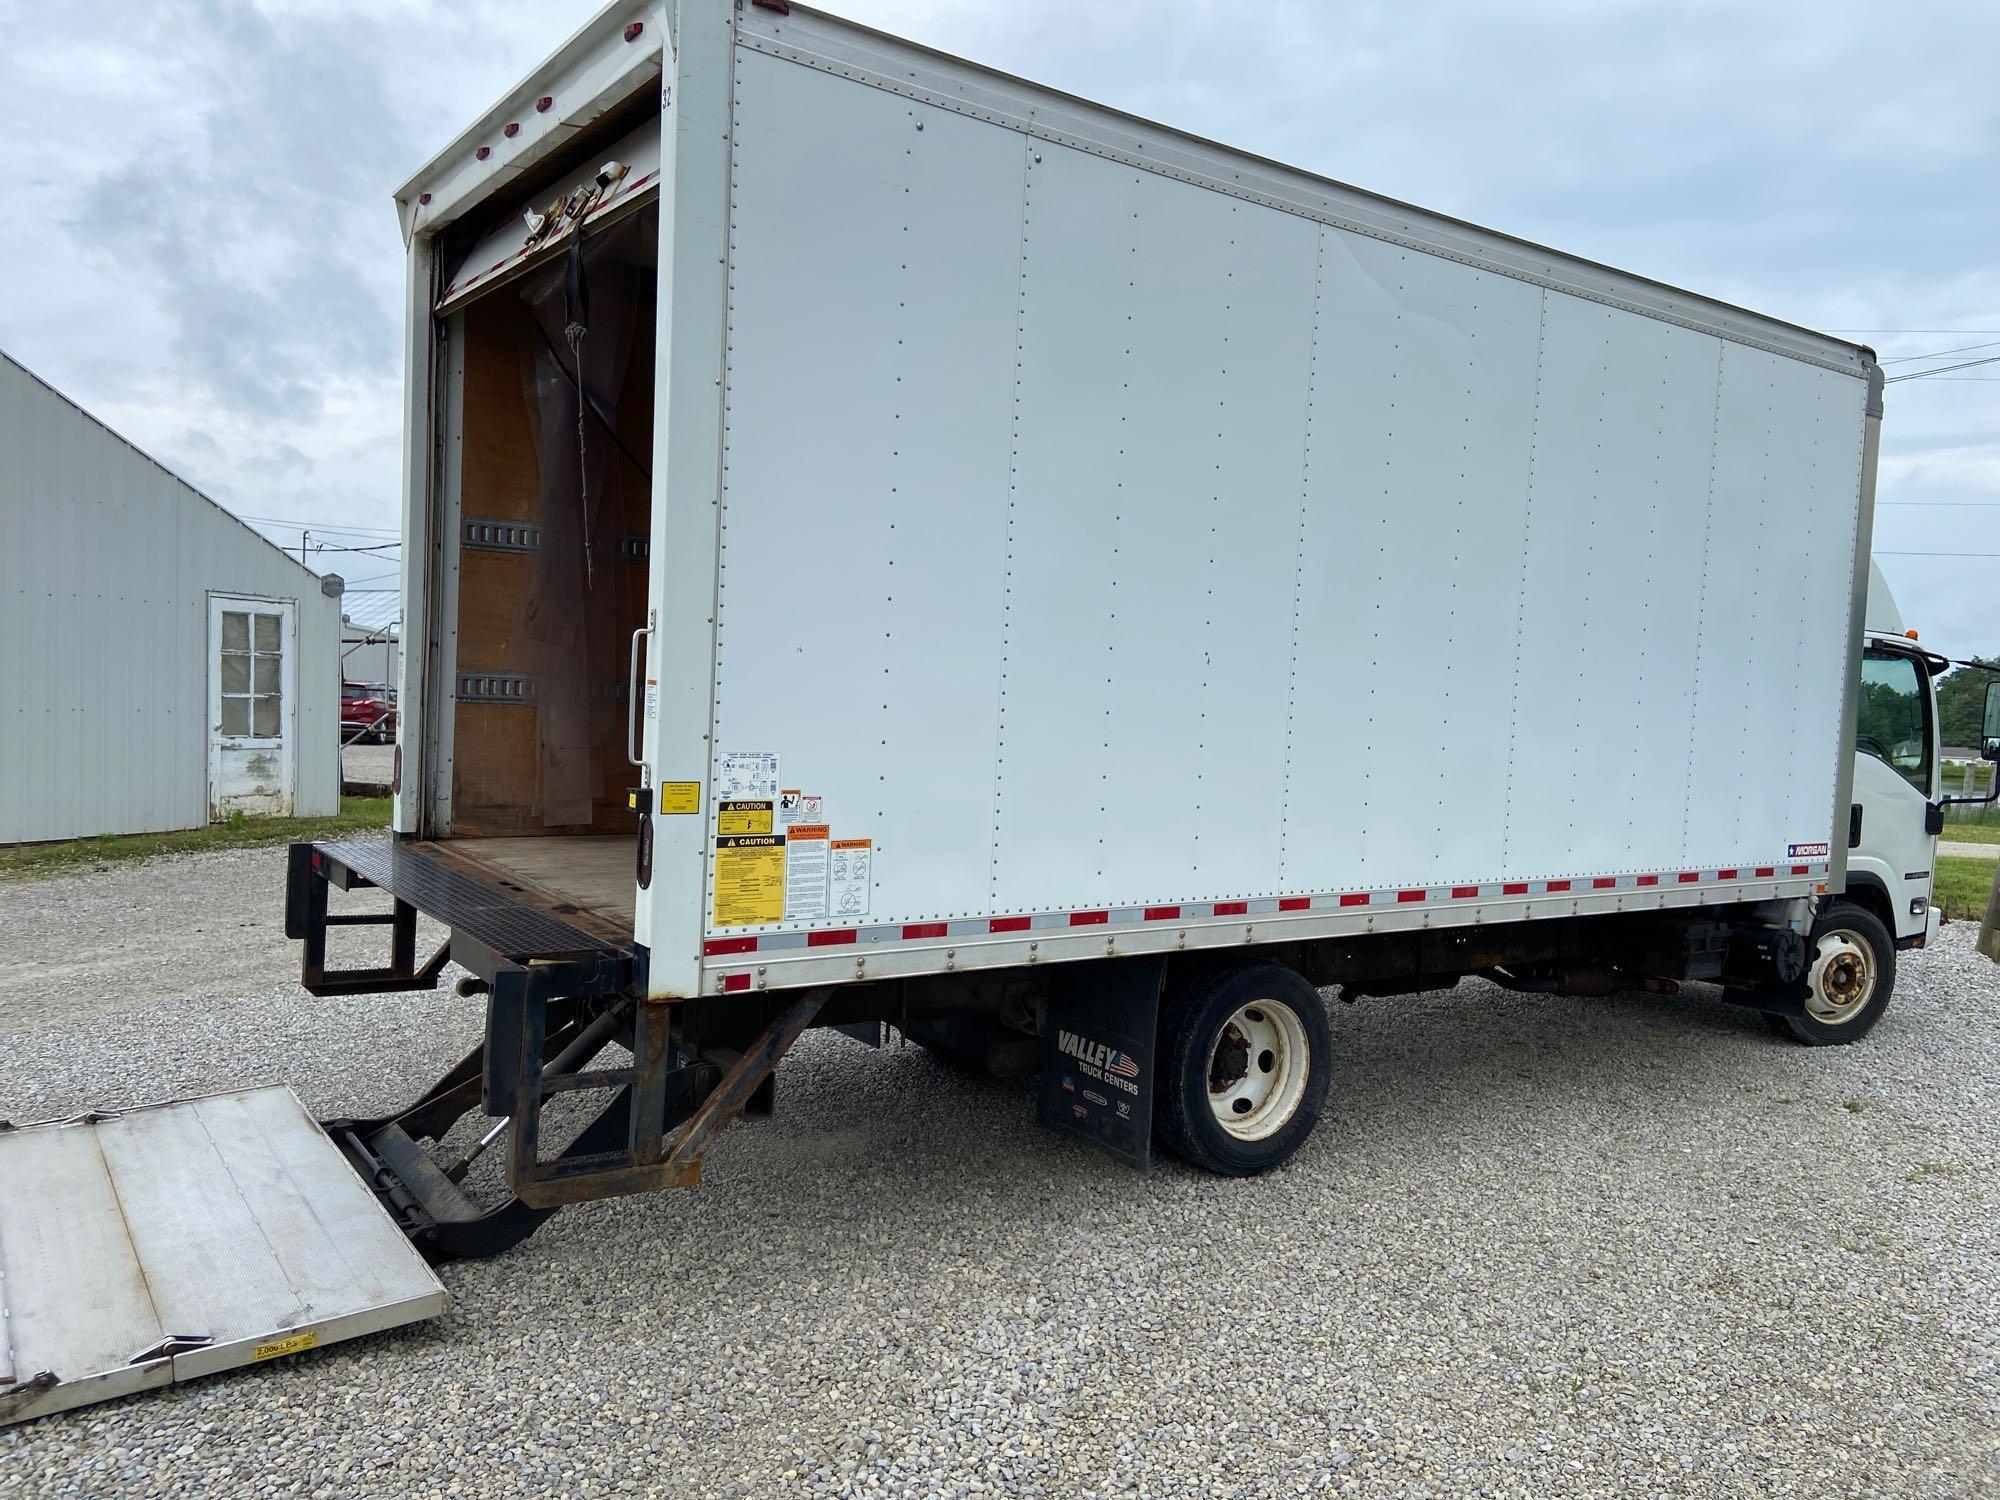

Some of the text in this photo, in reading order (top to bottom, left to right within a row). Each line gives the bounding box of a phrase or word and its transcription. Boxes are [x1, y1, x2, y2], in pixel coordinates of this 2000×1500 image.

[663, 86, 671, 110] 32
[1795, 845, 1827, 855] MORGAN
[1059, 1029, 1117, 1071] VALLEY
[1079, 1061, 1139, 1096] TRUCK CENTERS
